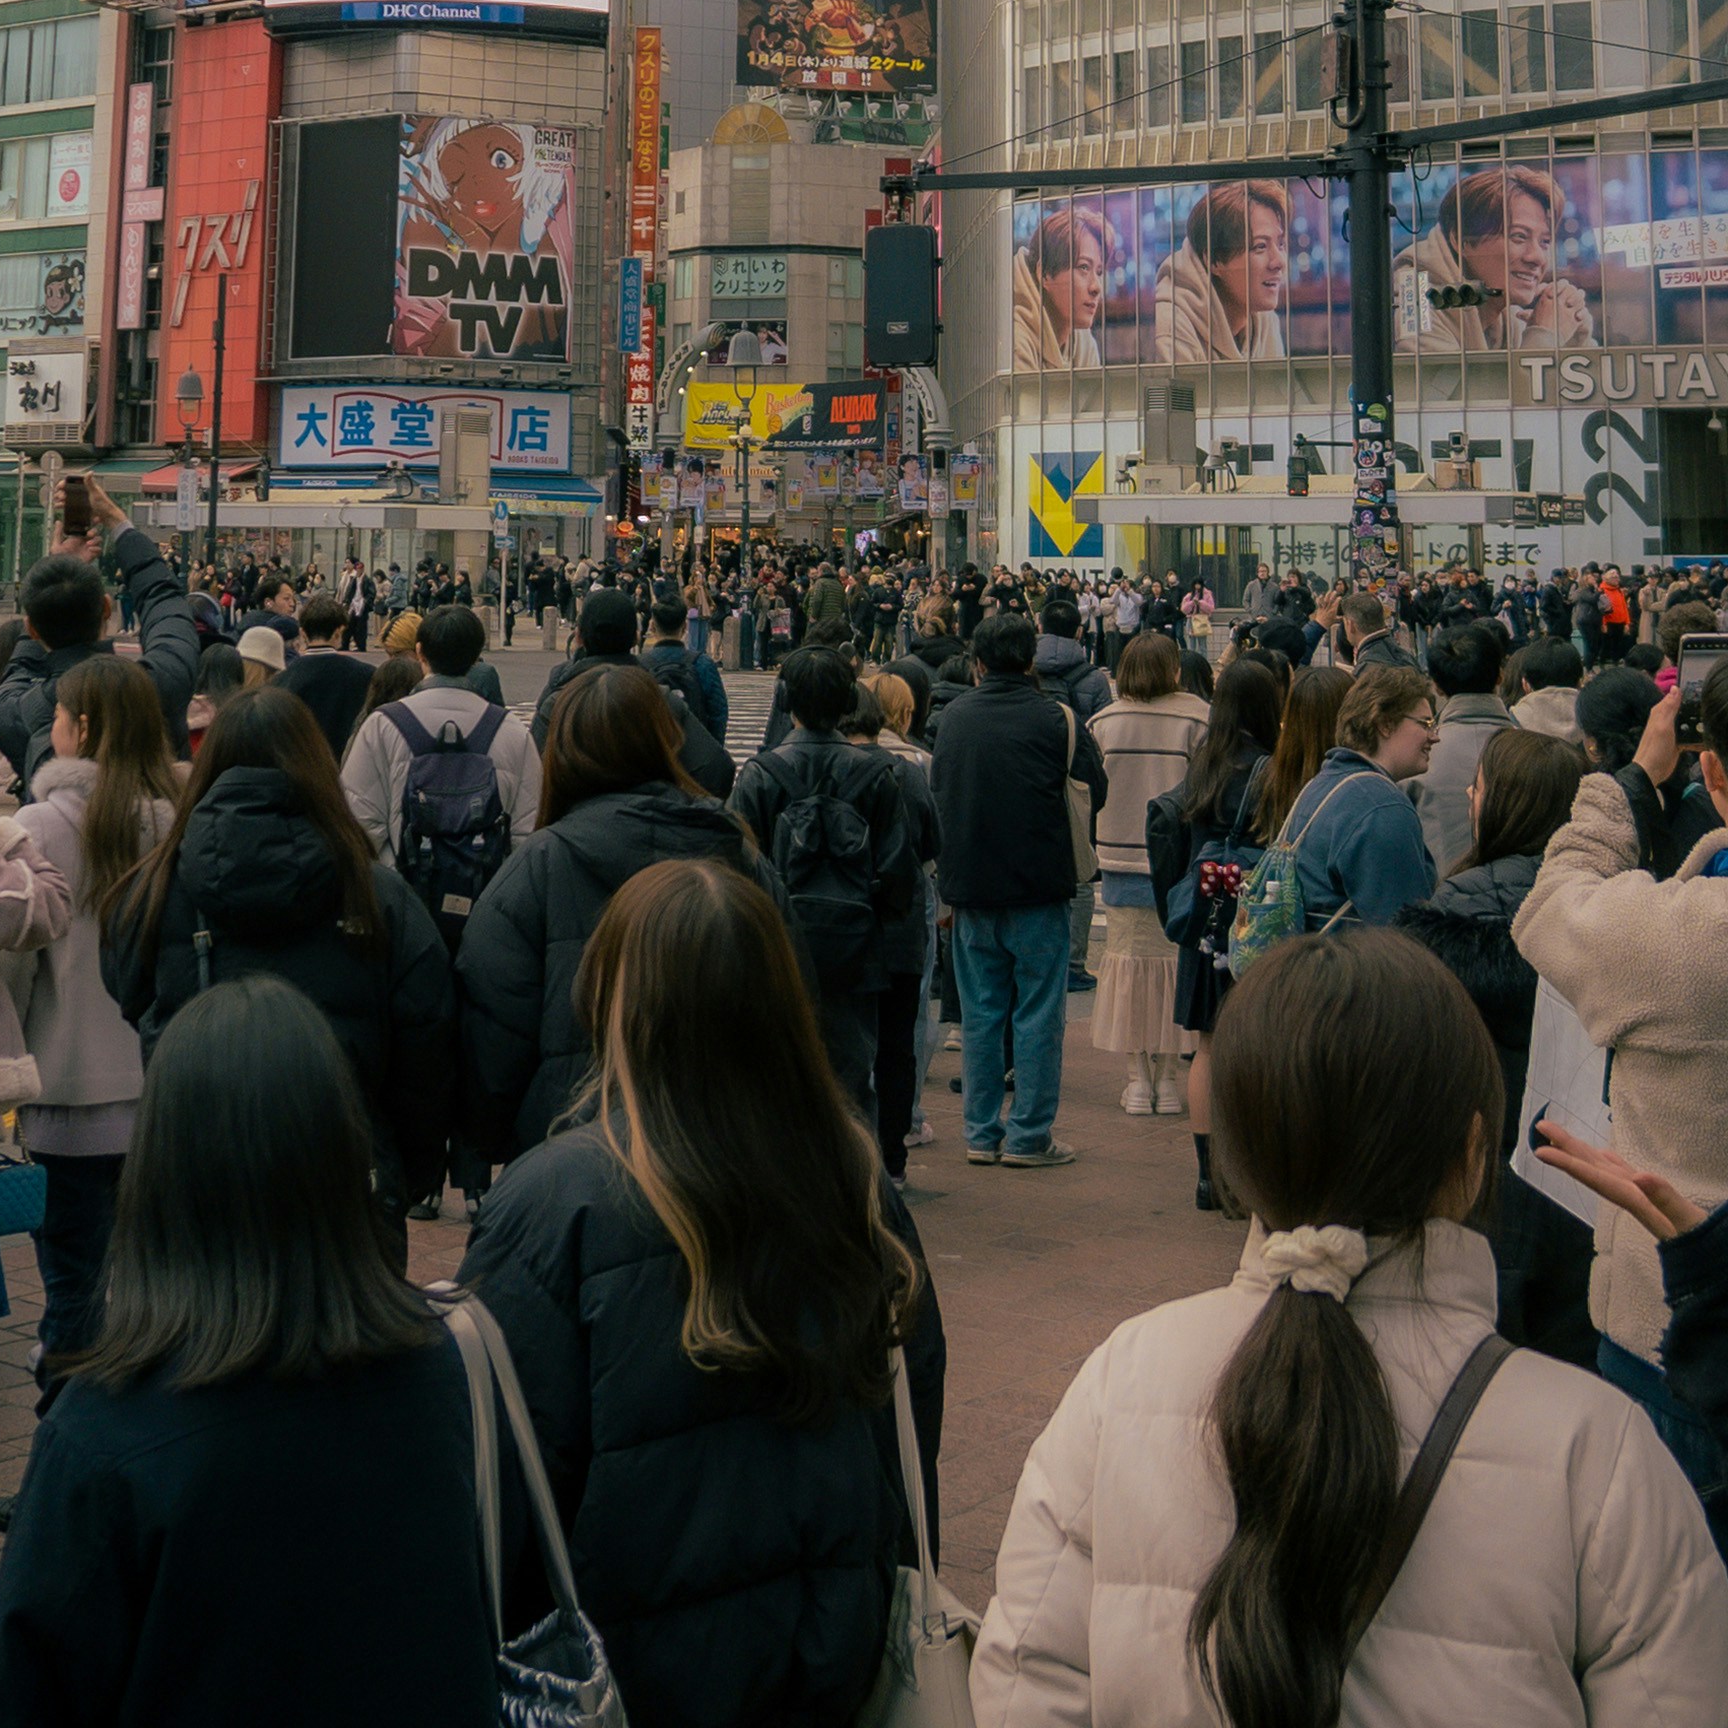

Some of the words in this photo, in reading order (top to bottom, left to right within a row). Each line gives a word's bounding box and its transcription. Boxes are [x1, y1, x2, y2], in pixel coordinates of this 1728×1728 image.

[383, 3, 418, 18] DHC
[419, 4, 481, 20] Channel
[637, 34, 660, 173] クスリのことなら
[535, 130, 573, 147] GREAT
[170, 180, 259, 327] クスリ
[408, 248, 564, 305] DMM
[732, 258, 787, 274] れいわ
[714, 278, 787, 296] クリニック
[449, 304, 524, 355] TV
[294, 400, 551, 452] 大盛堂店
